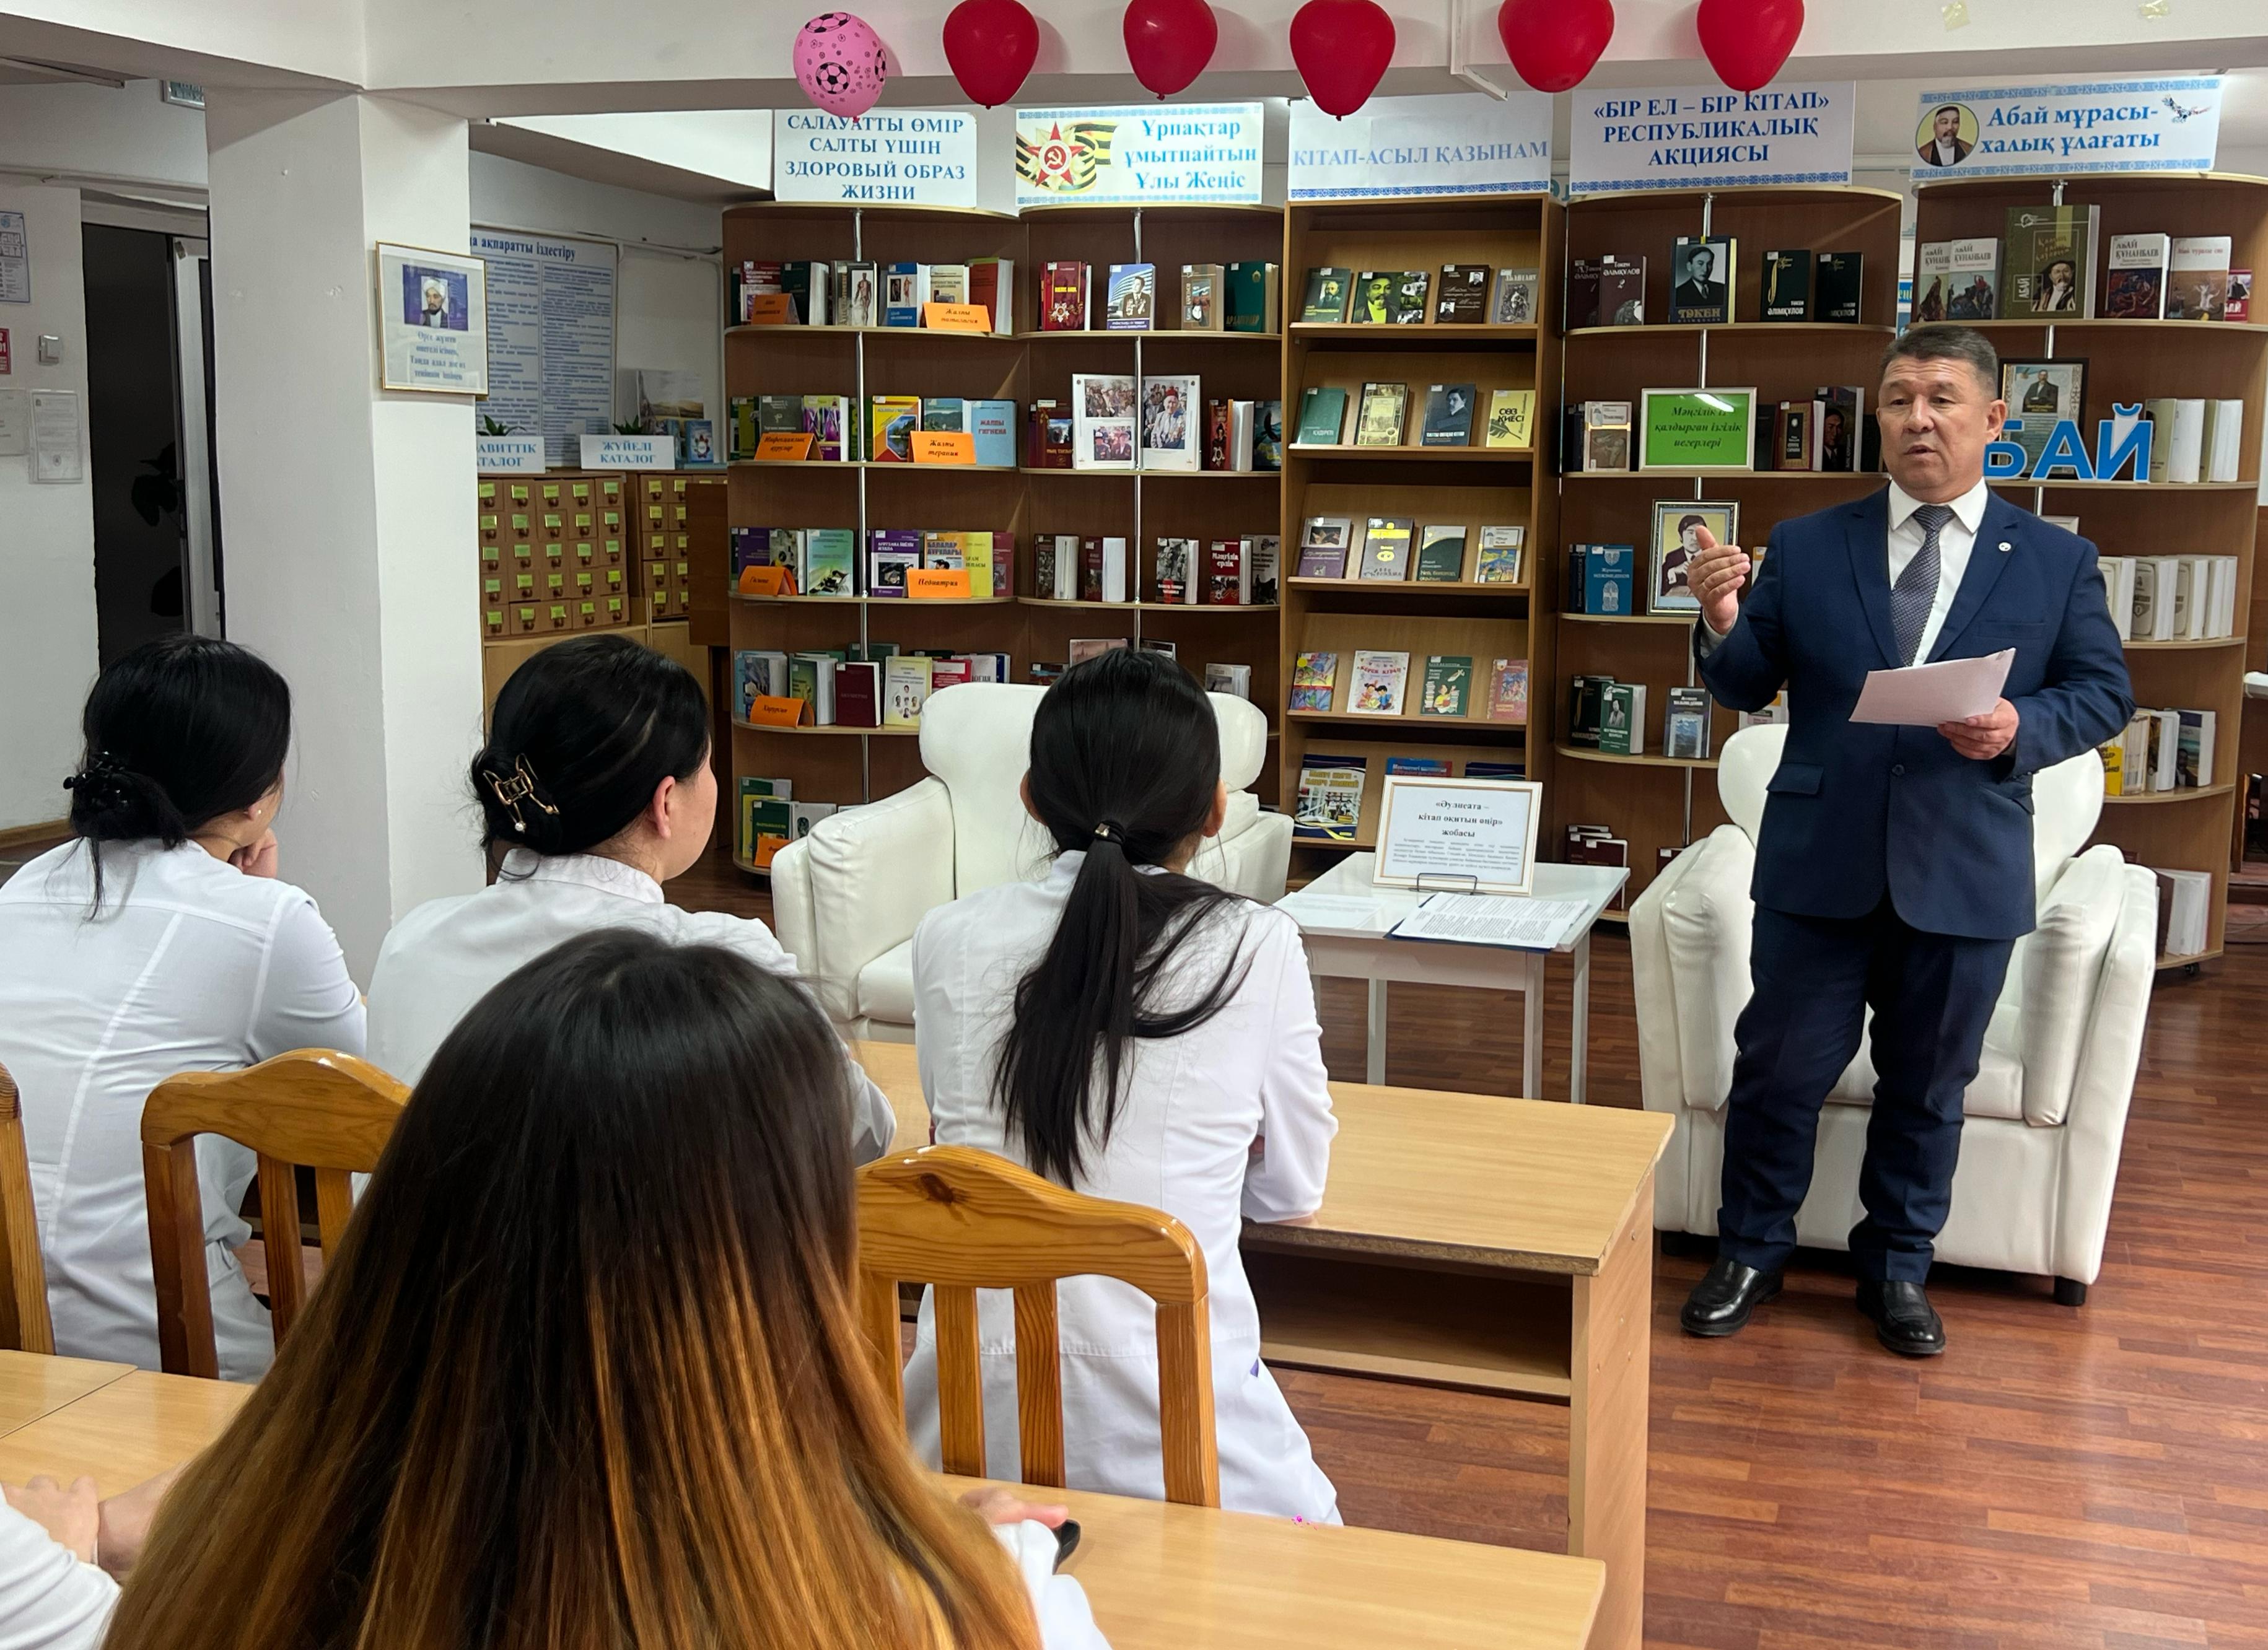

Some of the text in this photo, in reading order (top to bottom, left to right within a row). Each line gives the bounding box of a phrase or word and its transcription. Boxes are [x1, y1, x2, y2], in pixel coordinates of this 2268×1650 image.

[1594, 101, 1641, 118] «БІР
[1648, 99, 1677, 115] ЕЛ
[1701, 96, 1738, 114] БІР
[1745, 92, 1829, 111] КІТАП»
[787, 115, 963, 133] САЛАУАТТЫ ӨМІР
[1987, 104, 2158, 129] Абай мұрасы-
[1142, 119, 1240, 141] Ұрпақтар
[1603, 117, 1818, 142] РЕСПУБЛИКАЛЫҚ
[810, 138, 941, 154] САЛТЫ ҮШІН
[1294, 141, 1548, 166] КІТАП-АСЫЛ ҚАЗЫНАМ
[1979, 133, 2160, 157] халық ұлағаты
[1125, 146, 1256, 167] ұмытпайтын
[1648, 144, 1769, 167] АКЦИЯСЫ
[786, 159, 965, 179] ЗДОРОВЫЙ ОБРАЗ
[1136, 172, 1245, 190] Ұлы Жеңіс
[842, 185, 915, 199] ЖИЗНИ
[481, 238, 576, 261] ақпаратты іздестіру
[1671, 407, 1715, 417] Мәңгілік
[1655, 423, 1742, 433] қалдырған ізгілік
[478, 443, 536, 453] АВИТТІК
[603, 439, 652, 451] ЖҮЙЕЛІ
[1984, 403, 2153, 481] БАЙ
[477, 457, 524, 466] ТАЛОГ
[600, 455, 655, 463] КАТАЛОГ
[1418, 813, 1442, 822] кітап
[1442, 829, 1475, 837] жобасы
